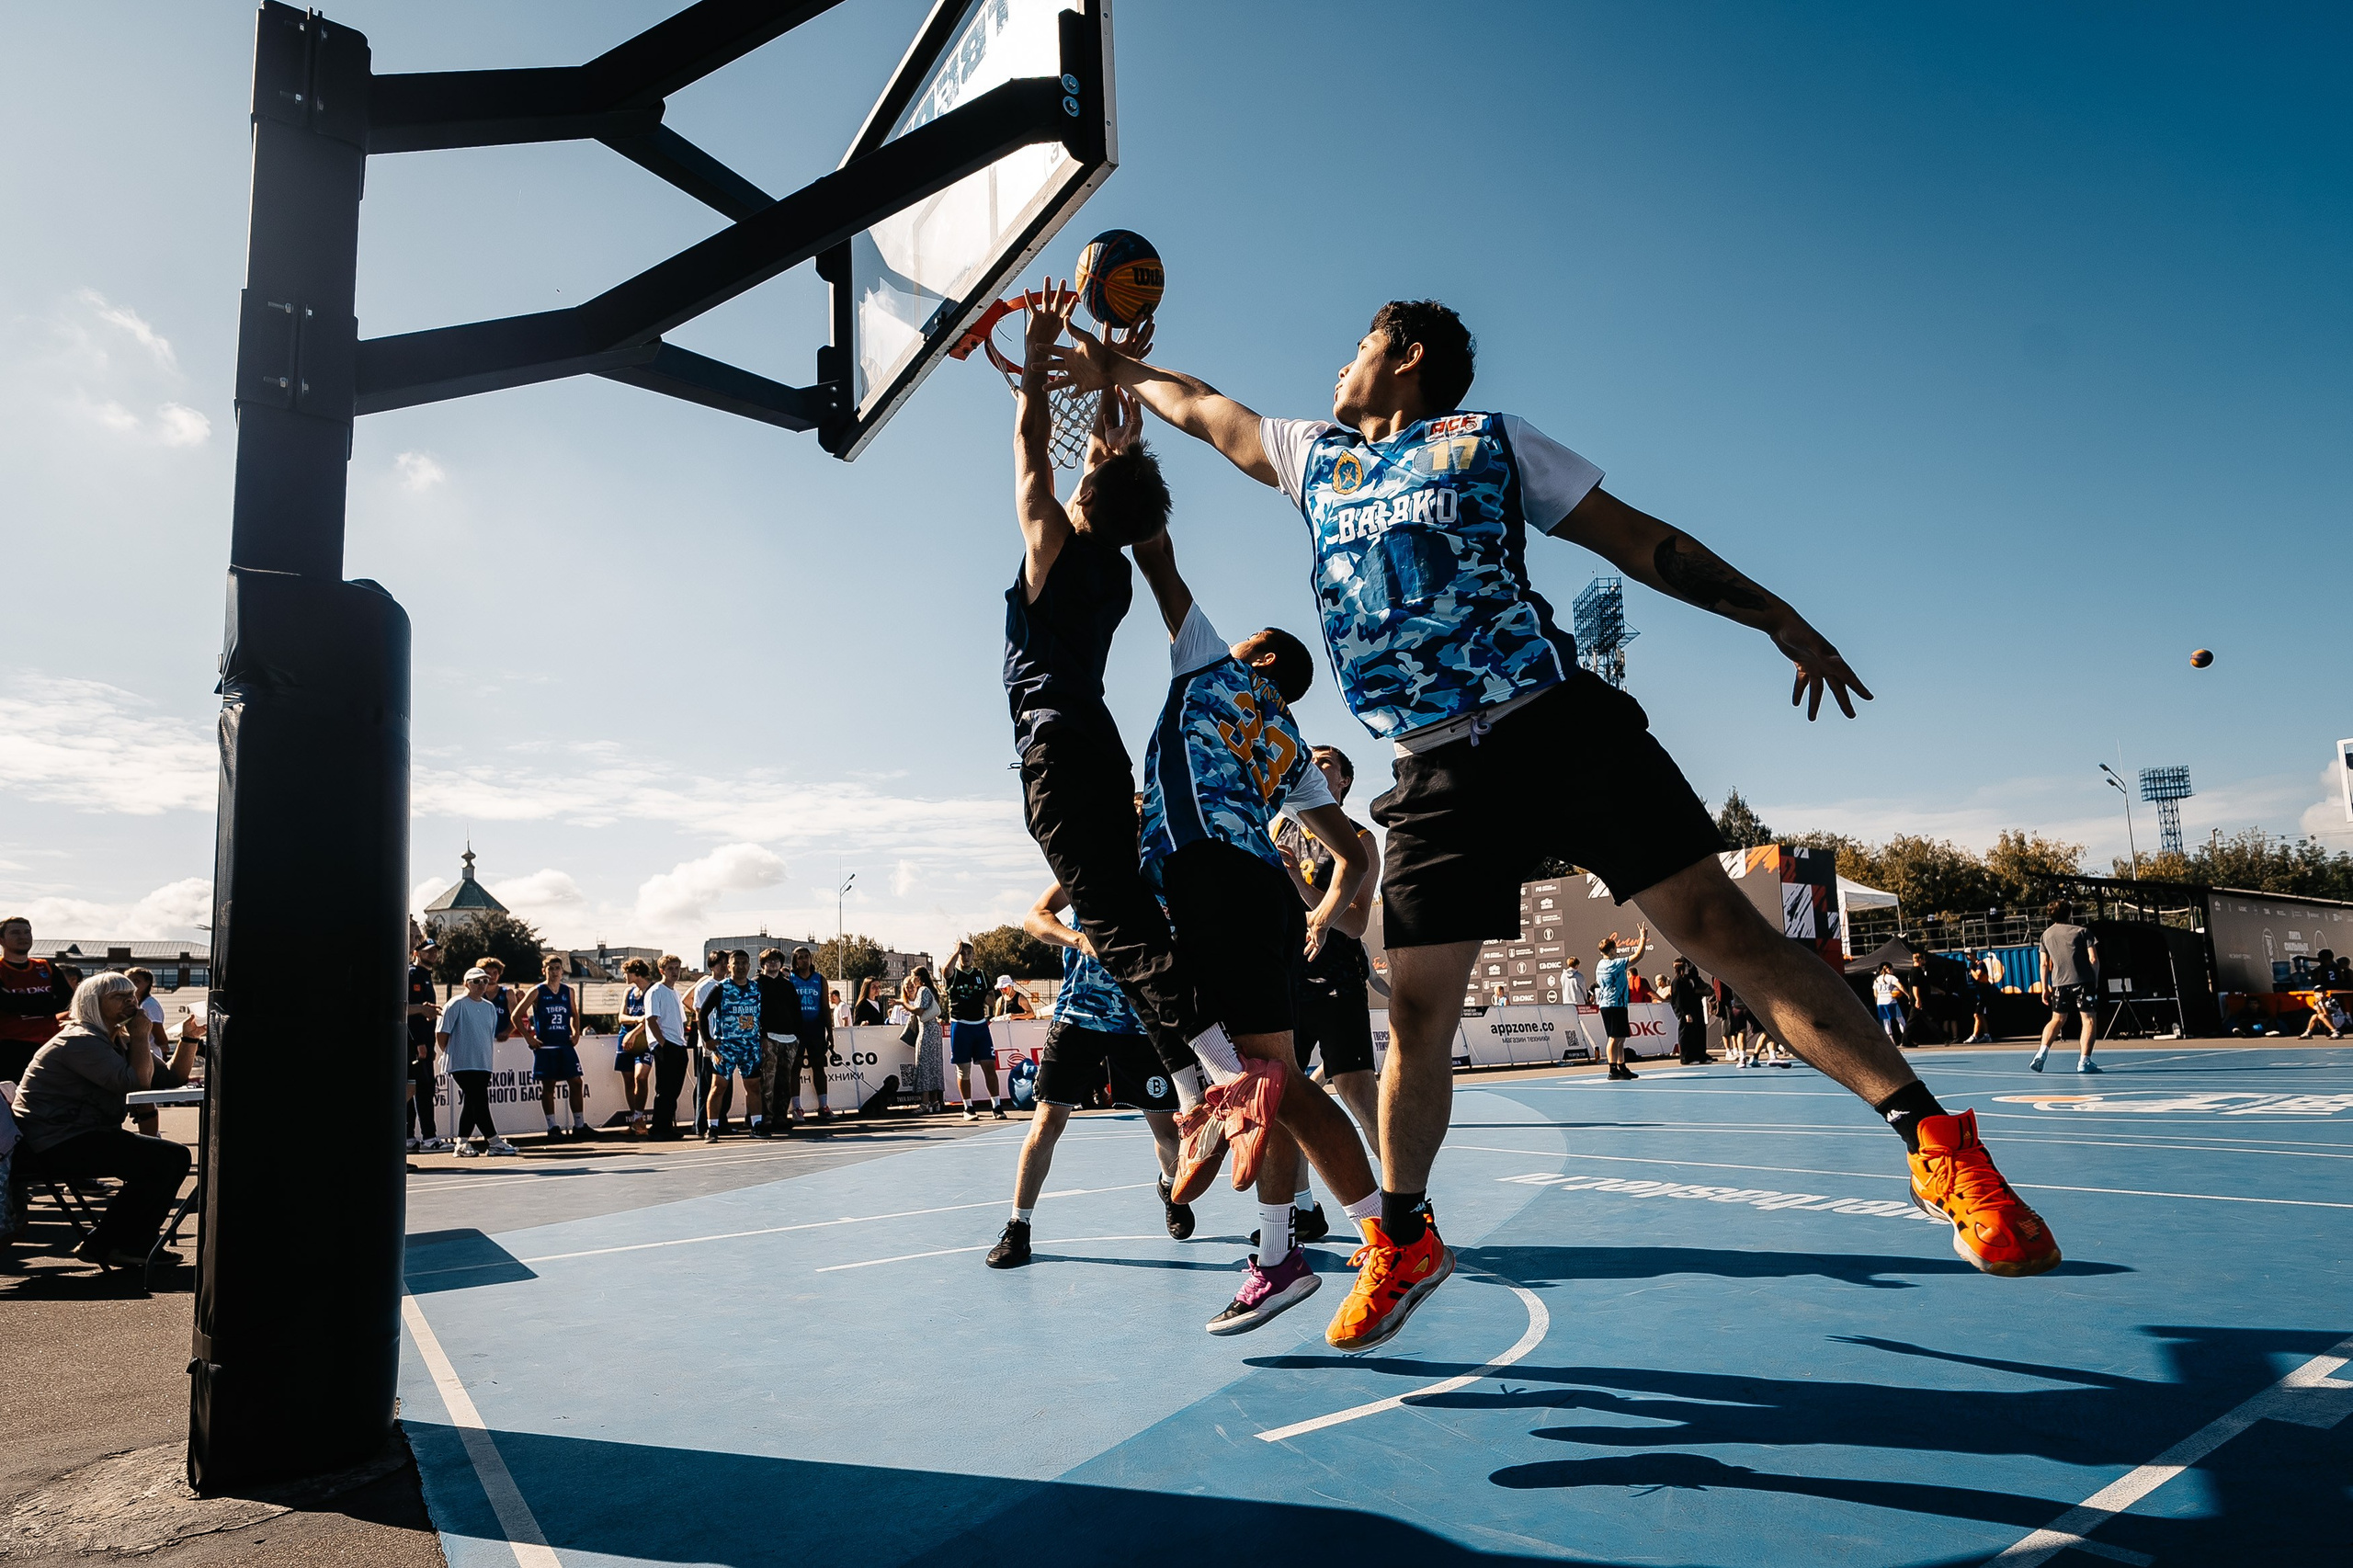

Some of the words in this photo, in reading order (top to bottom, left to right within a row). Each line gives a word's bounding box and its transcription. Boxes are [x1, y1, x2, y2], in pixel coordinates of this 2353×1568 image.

[1427, 437, 1481, 471] 17
[551, 1014, 563, 1025] 23
[1490, 1022, 1555, 1037] appzone.co
[1629, 1020, 1666, 1037] DKC
[1153, 1079, 1162, 1095] B
[1495, 1172, 1950, 1225] verbasket.ru
